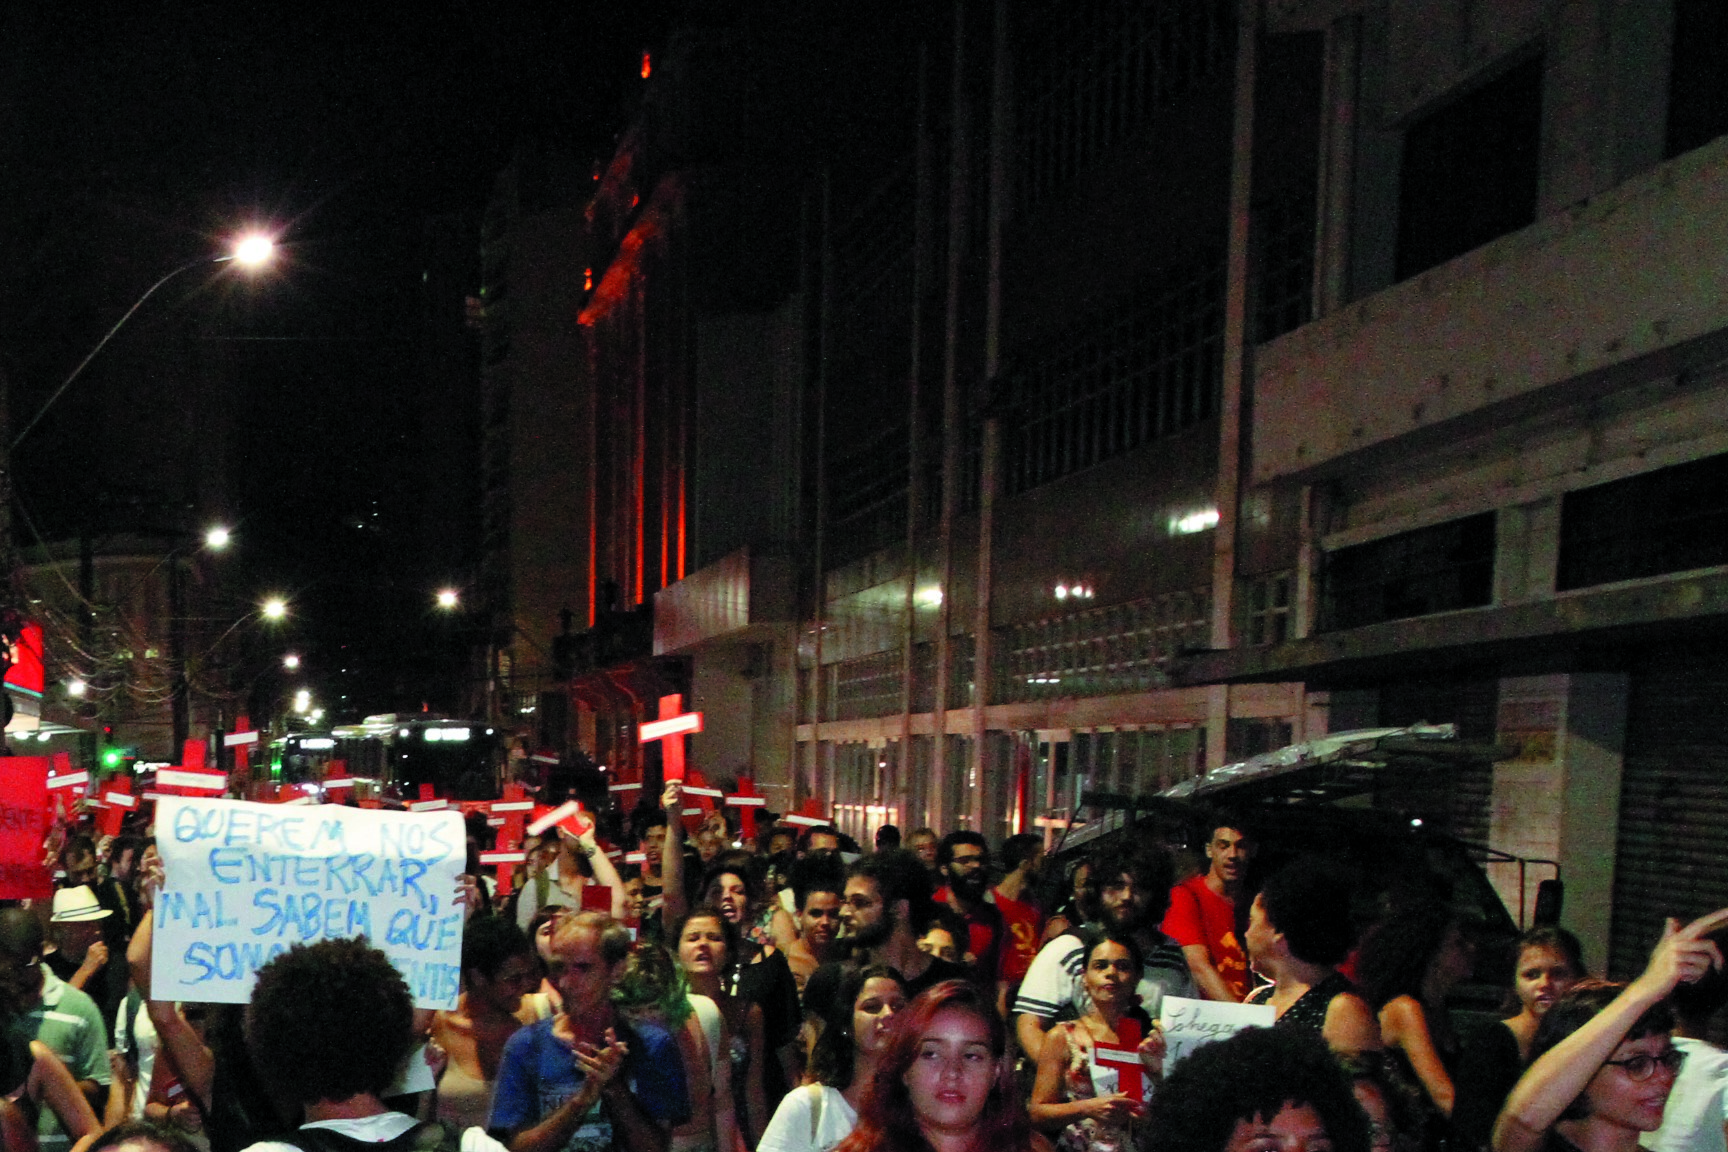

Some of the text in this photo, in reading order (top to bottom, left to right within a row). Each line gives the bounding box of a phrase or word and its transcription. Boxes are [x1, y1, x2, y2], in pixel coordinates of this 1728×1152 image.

[174, 805, 453, 859] QUEREM NOS
[158, 887, 460, 951] MAL SABEM QUE
